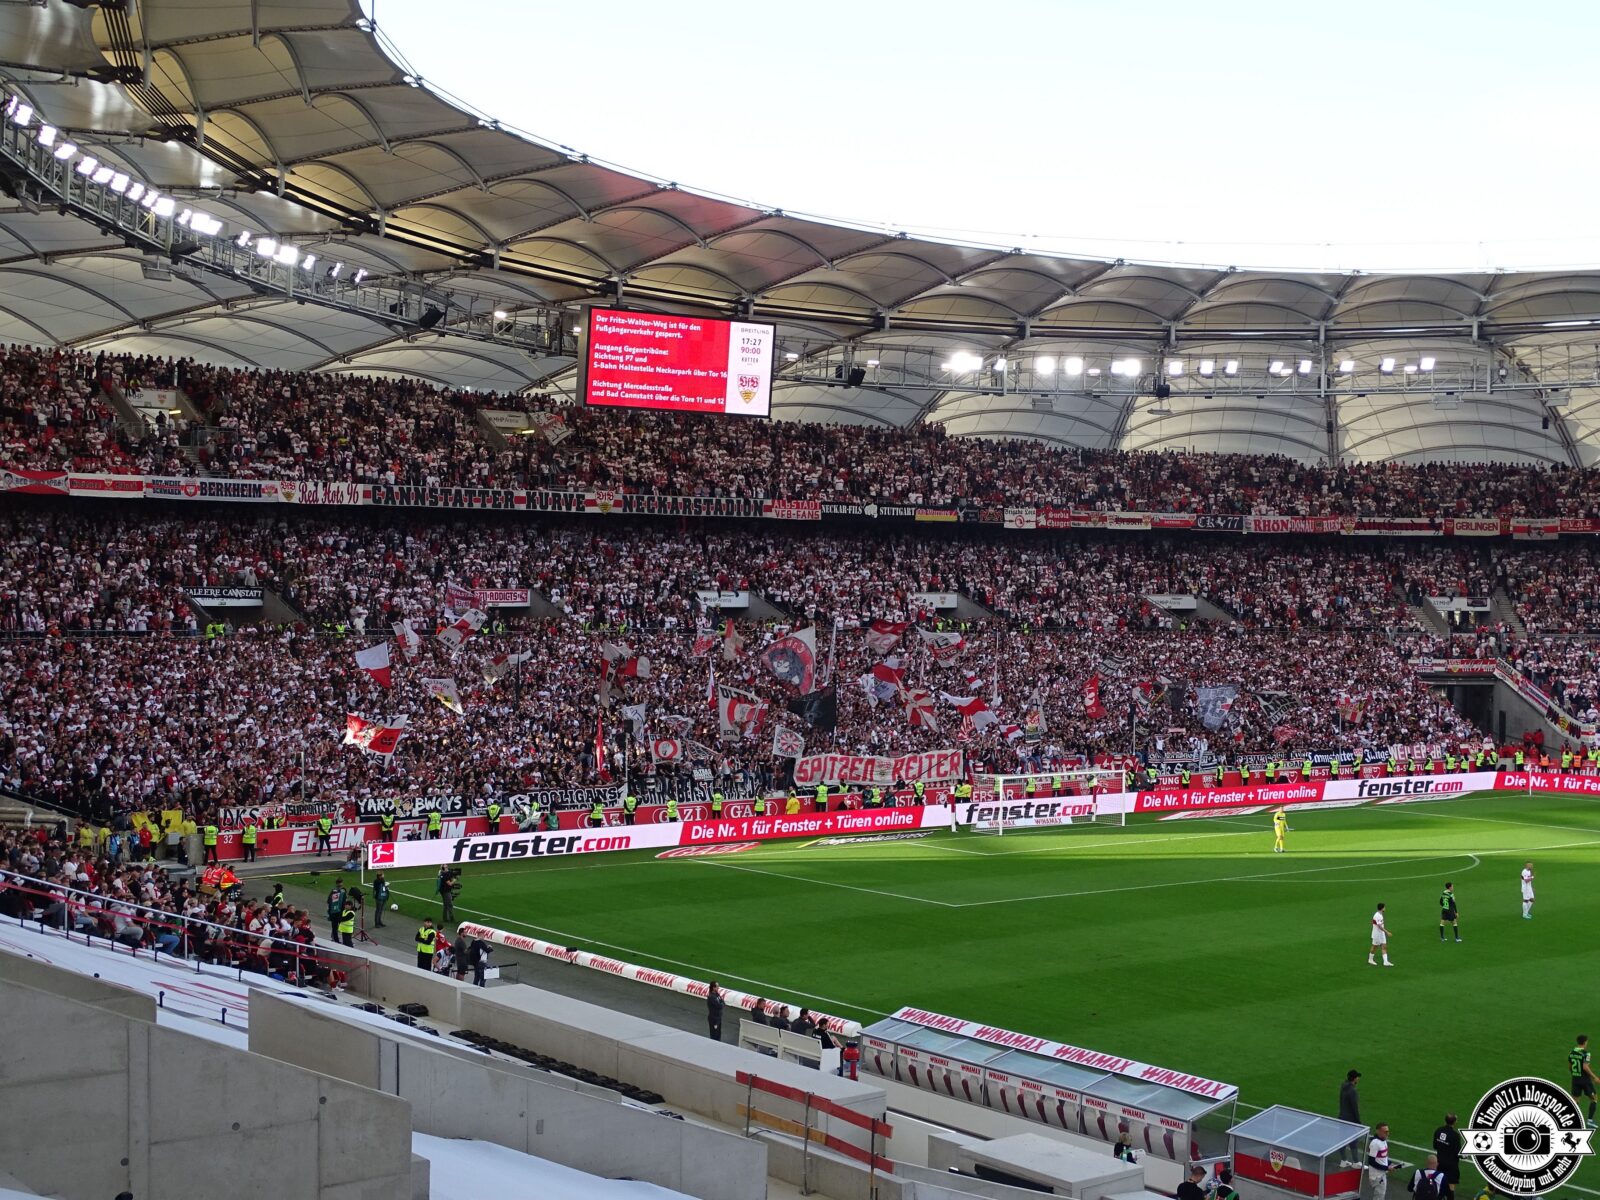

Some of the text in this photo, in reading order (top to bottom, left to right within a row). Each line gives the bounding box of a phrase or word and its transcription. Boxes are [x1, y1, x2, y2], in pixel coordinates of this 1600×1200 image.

[609, 316, 668, 329] Fritz-Walter-Weg
[679, 322, 689, 330] für
[596, 324, 683, 339] Fußgängerverkehr gesperrt.
[594, 343, 622, 353] Ausgang
[740, 346, 761, 354] 90:00
[741, 338, 762, 346] 17:27
[594, 352, 623, 362] Richtung
[593, 361, 617, 370] S-Bahn
[618, 363, 655, 372] Haltestelle
[655, 366, 692, 376] Neckarpark
[592, 380, 673, 392] Richtung Mercedesstraße
[620, 391, 654, 400] Cannstatt
[200, 481, 262, 498] BERKHEIM
[298, 481, 359, 504] Red Hots 96
[371, 485, 585, 510] CANNSTATTER KURVE
[622, 495, 764, 517] NECKARSTADION
[773, 500, 820, 510] ALBSTADT
[821, 504, 862, 515] NECKAR-FILS
[879, 506, 916, 516] STUTTGART
[774, 510, 820, 520] VFB-FANS
[1227, 517, 1240, 528] 77
[1455, 522, 1498, 532] GERLINGEN
[796, 755, 876, 782] SPITZEN
[892, 752, 961, 782] REITER
[1358, 776, 1463, 797] fenster.com
[1504, 775, 1526, 787] Die
[1530, 776, 1550, 788] Nr.
[1554, 779, 1560, 788] 1
[1563, 778, 1582, 790] für
[527, 787, 618, 806] HOOLIGANS
[803, 798, 811, 806] 34
[1143, 786, 1317, 808] Die Nr. 1 für Fenster + Türen online
[358, 798, 394, 814] YARD
[730, 802, 772, 818] GAI
[965, 802, 1097, 824] fenster.com
[223, 808, 259, 828] DKS
[690, 811, 913, 840] Die Nr. 1 für Fenster + Türen online
[987, 820, 1016, 828] WINMAX
[223, 834, 233, 844] 32
[396, 820, 466, 842] EHIM
[452, 836, 630, 862] fenster.com
[504, 934, 536, 951] WINAMAX
[589, 957, 625, 974] WINAMAX
[636, 969, 676, 988] WINAMAX
[900, 1008, 1229, 1097] WINAMAX WINAMAX WINAMAX WINAMAX
[1571, 1058, 1582, 1072] 21
[869, 1040, 1184, 1130] WINAMAX WINAMAX WINAMAX WINAMAX WINAMAX WINAMAX WINAMAX WINAMAX WINAMAX WINAMAX
